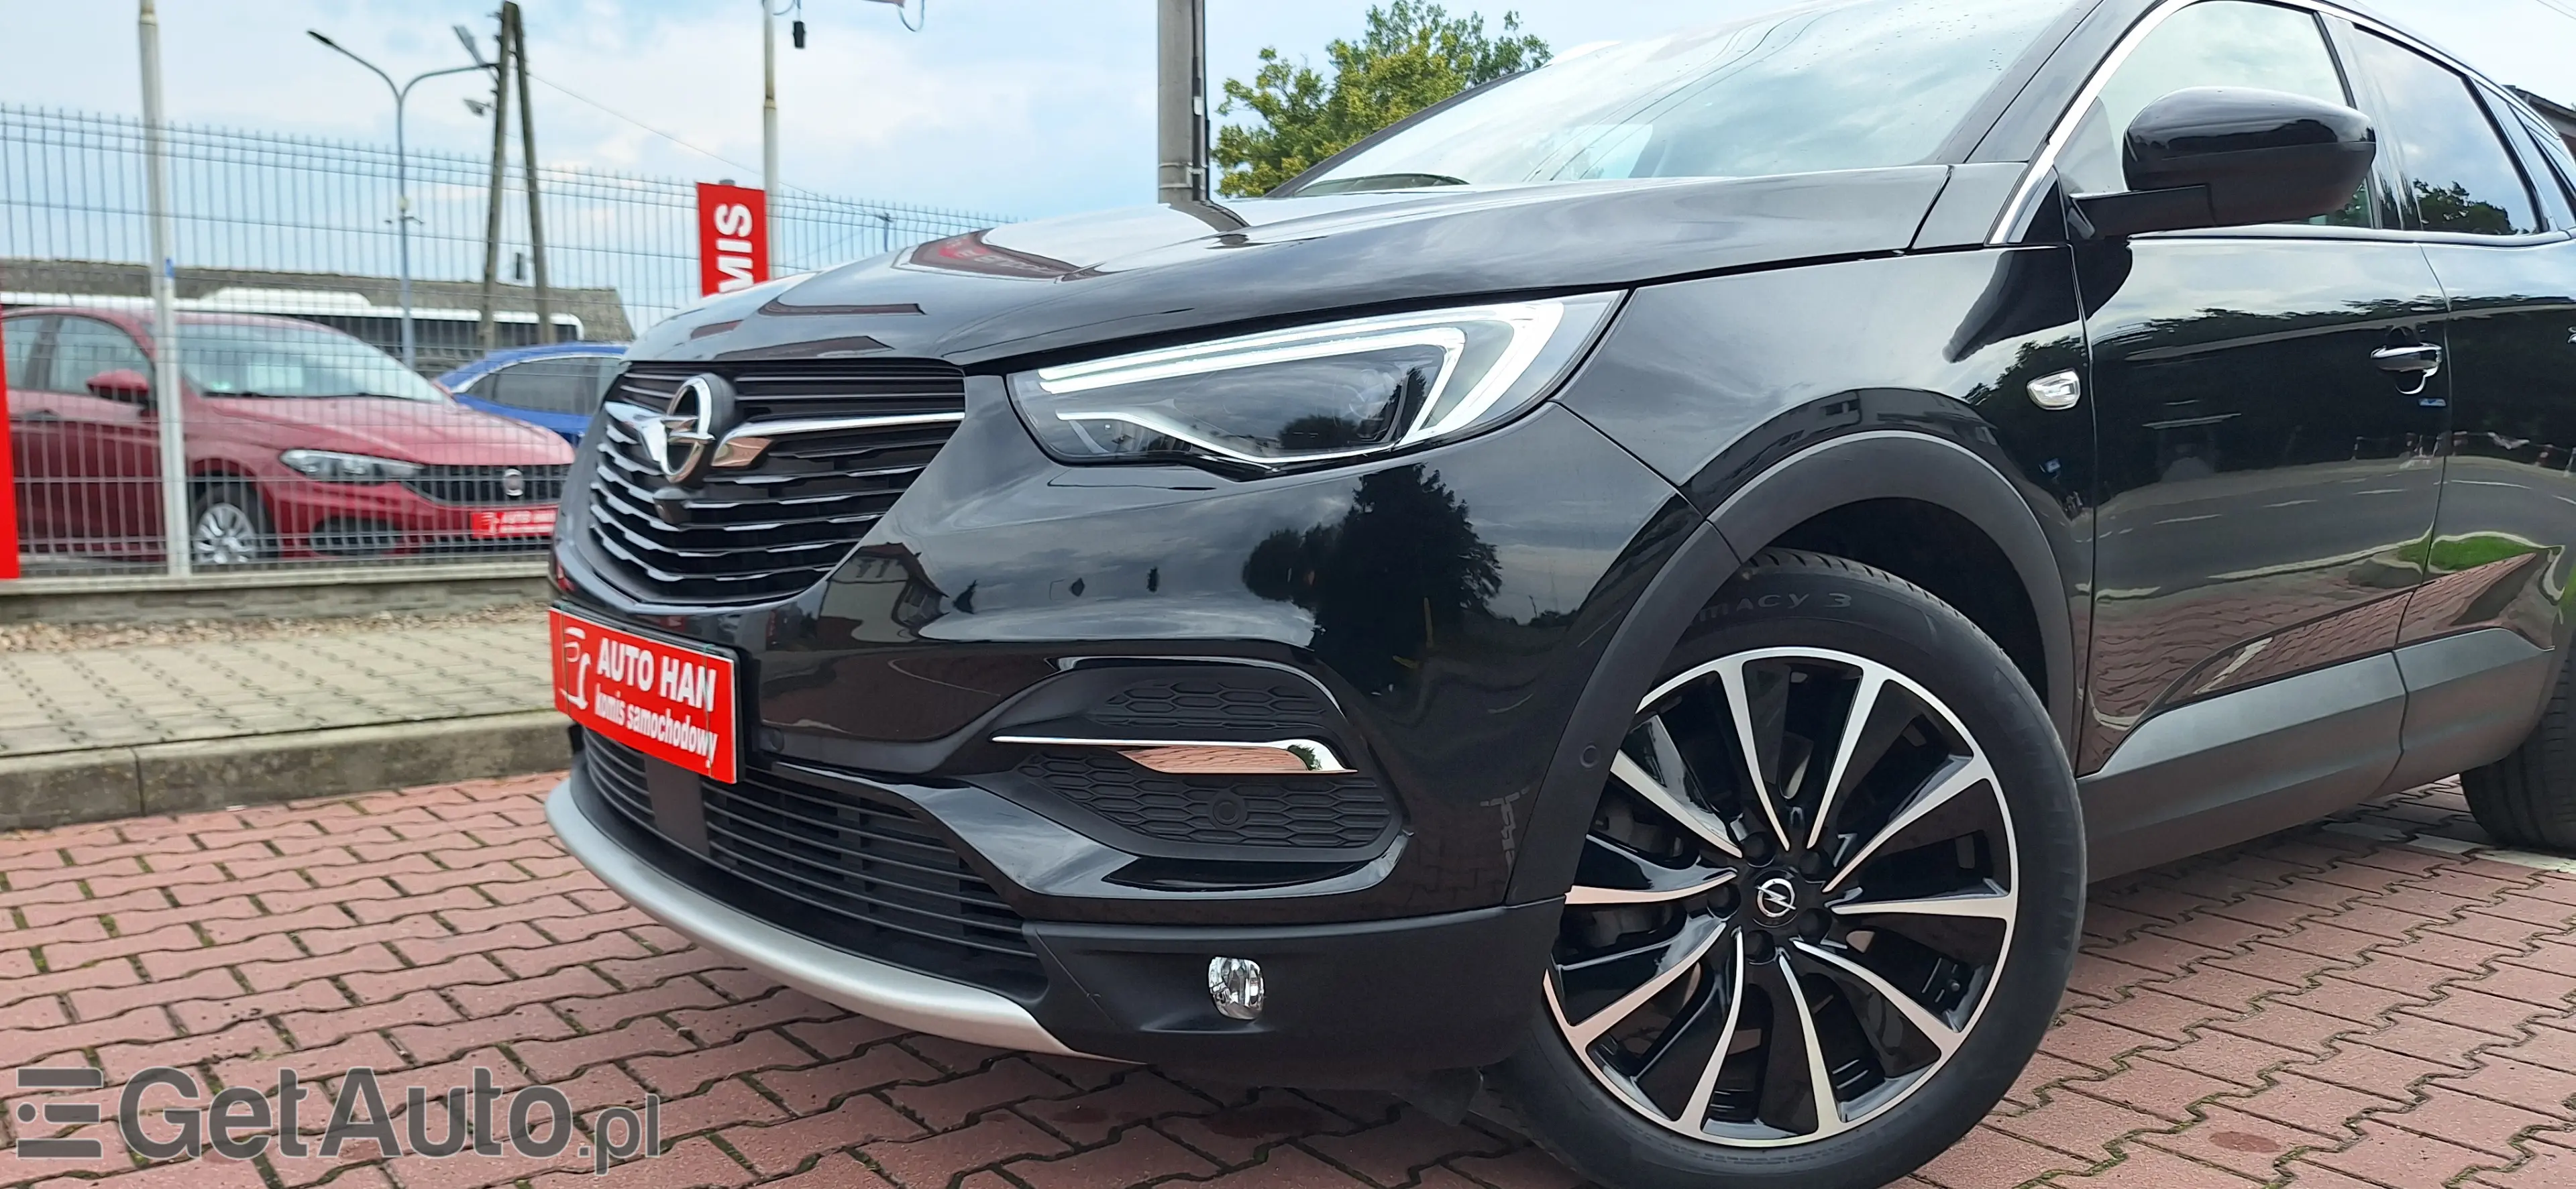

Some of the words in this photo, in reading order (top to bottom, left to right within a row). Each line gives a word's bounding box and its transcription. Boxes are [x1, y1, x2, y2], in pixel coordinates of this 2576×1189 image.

[714, 203, 754, 293] MIS
[1824, 592, 1852, 608] 3
[596, 636, 655, 692] AUTO
[659, 655, 717, 713] HAN
[594, 682, 626, 727] komis
[627, 703, 718, 769] samochodowy
